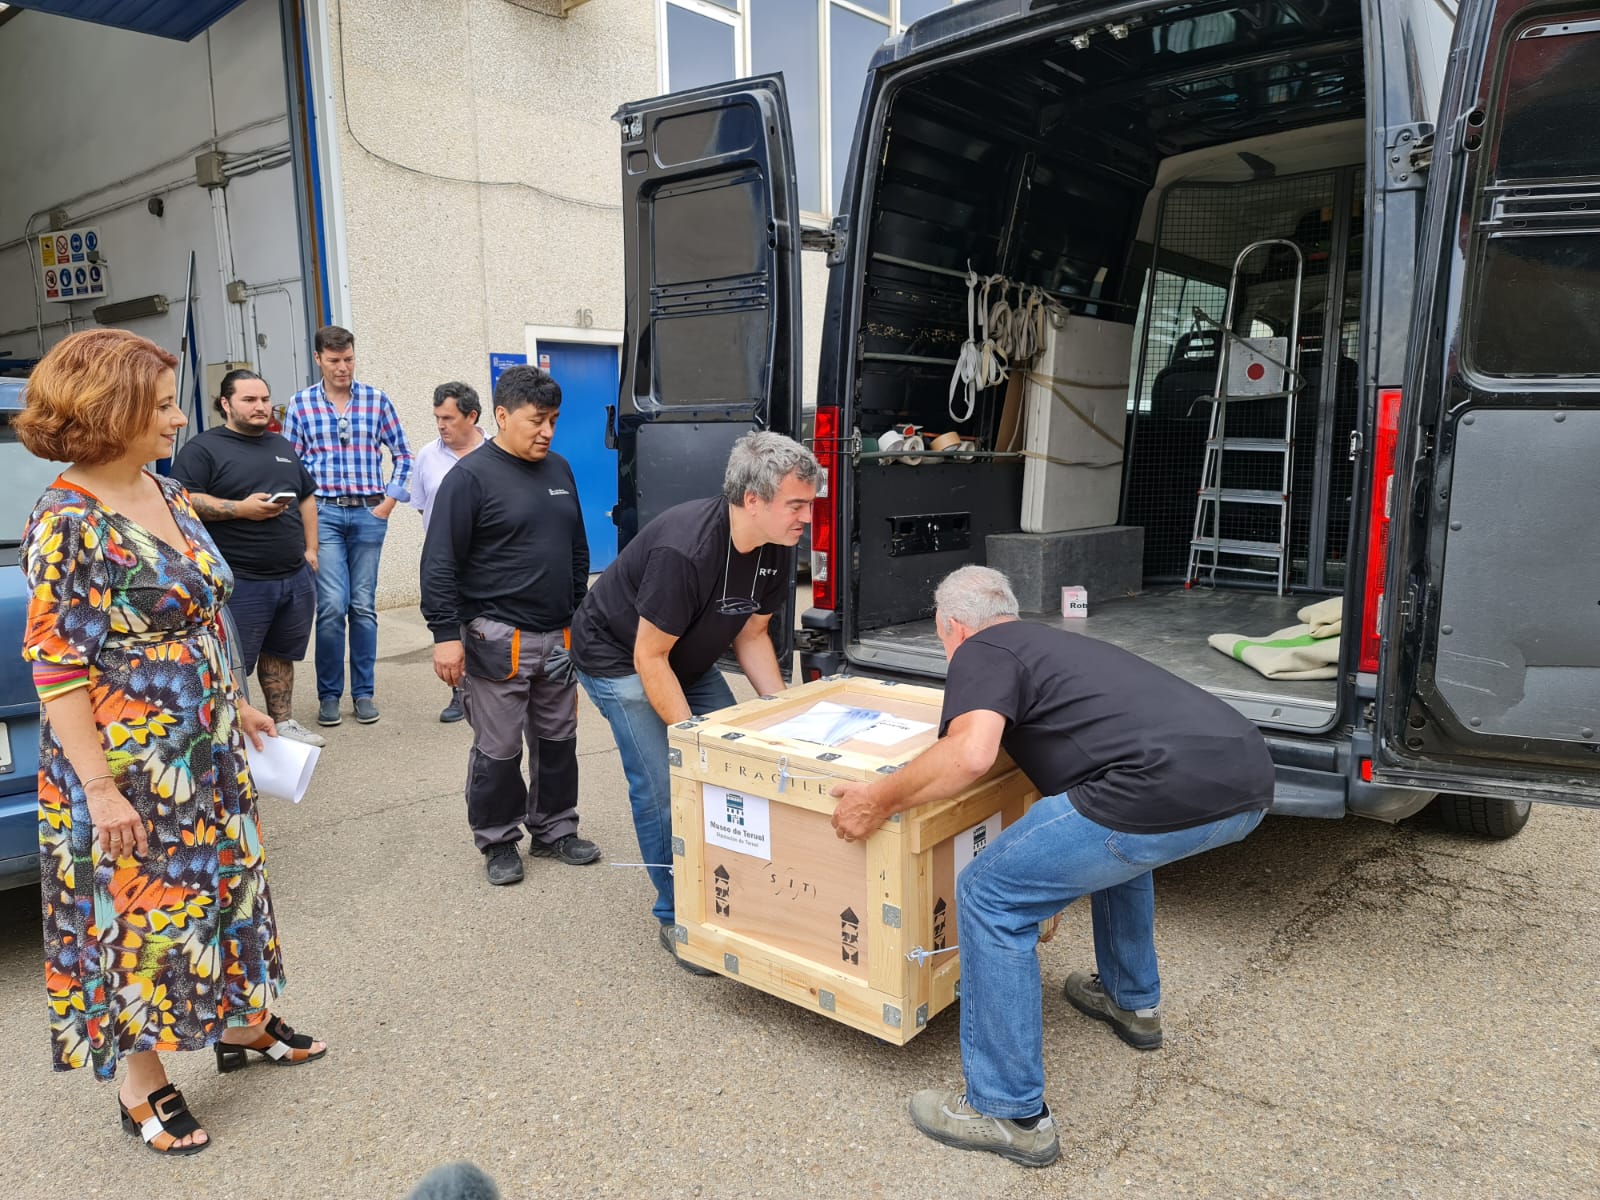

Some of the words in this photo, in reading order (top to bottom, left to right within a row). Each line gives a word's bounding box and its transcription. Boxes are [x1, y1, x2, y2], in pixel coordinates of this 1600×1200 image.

[575, 308, 593, 328] 16
[709, 820, 731, 833] Museo
[732, 827, 741, 836] de
[742, 829, 765, 842] Teruel
